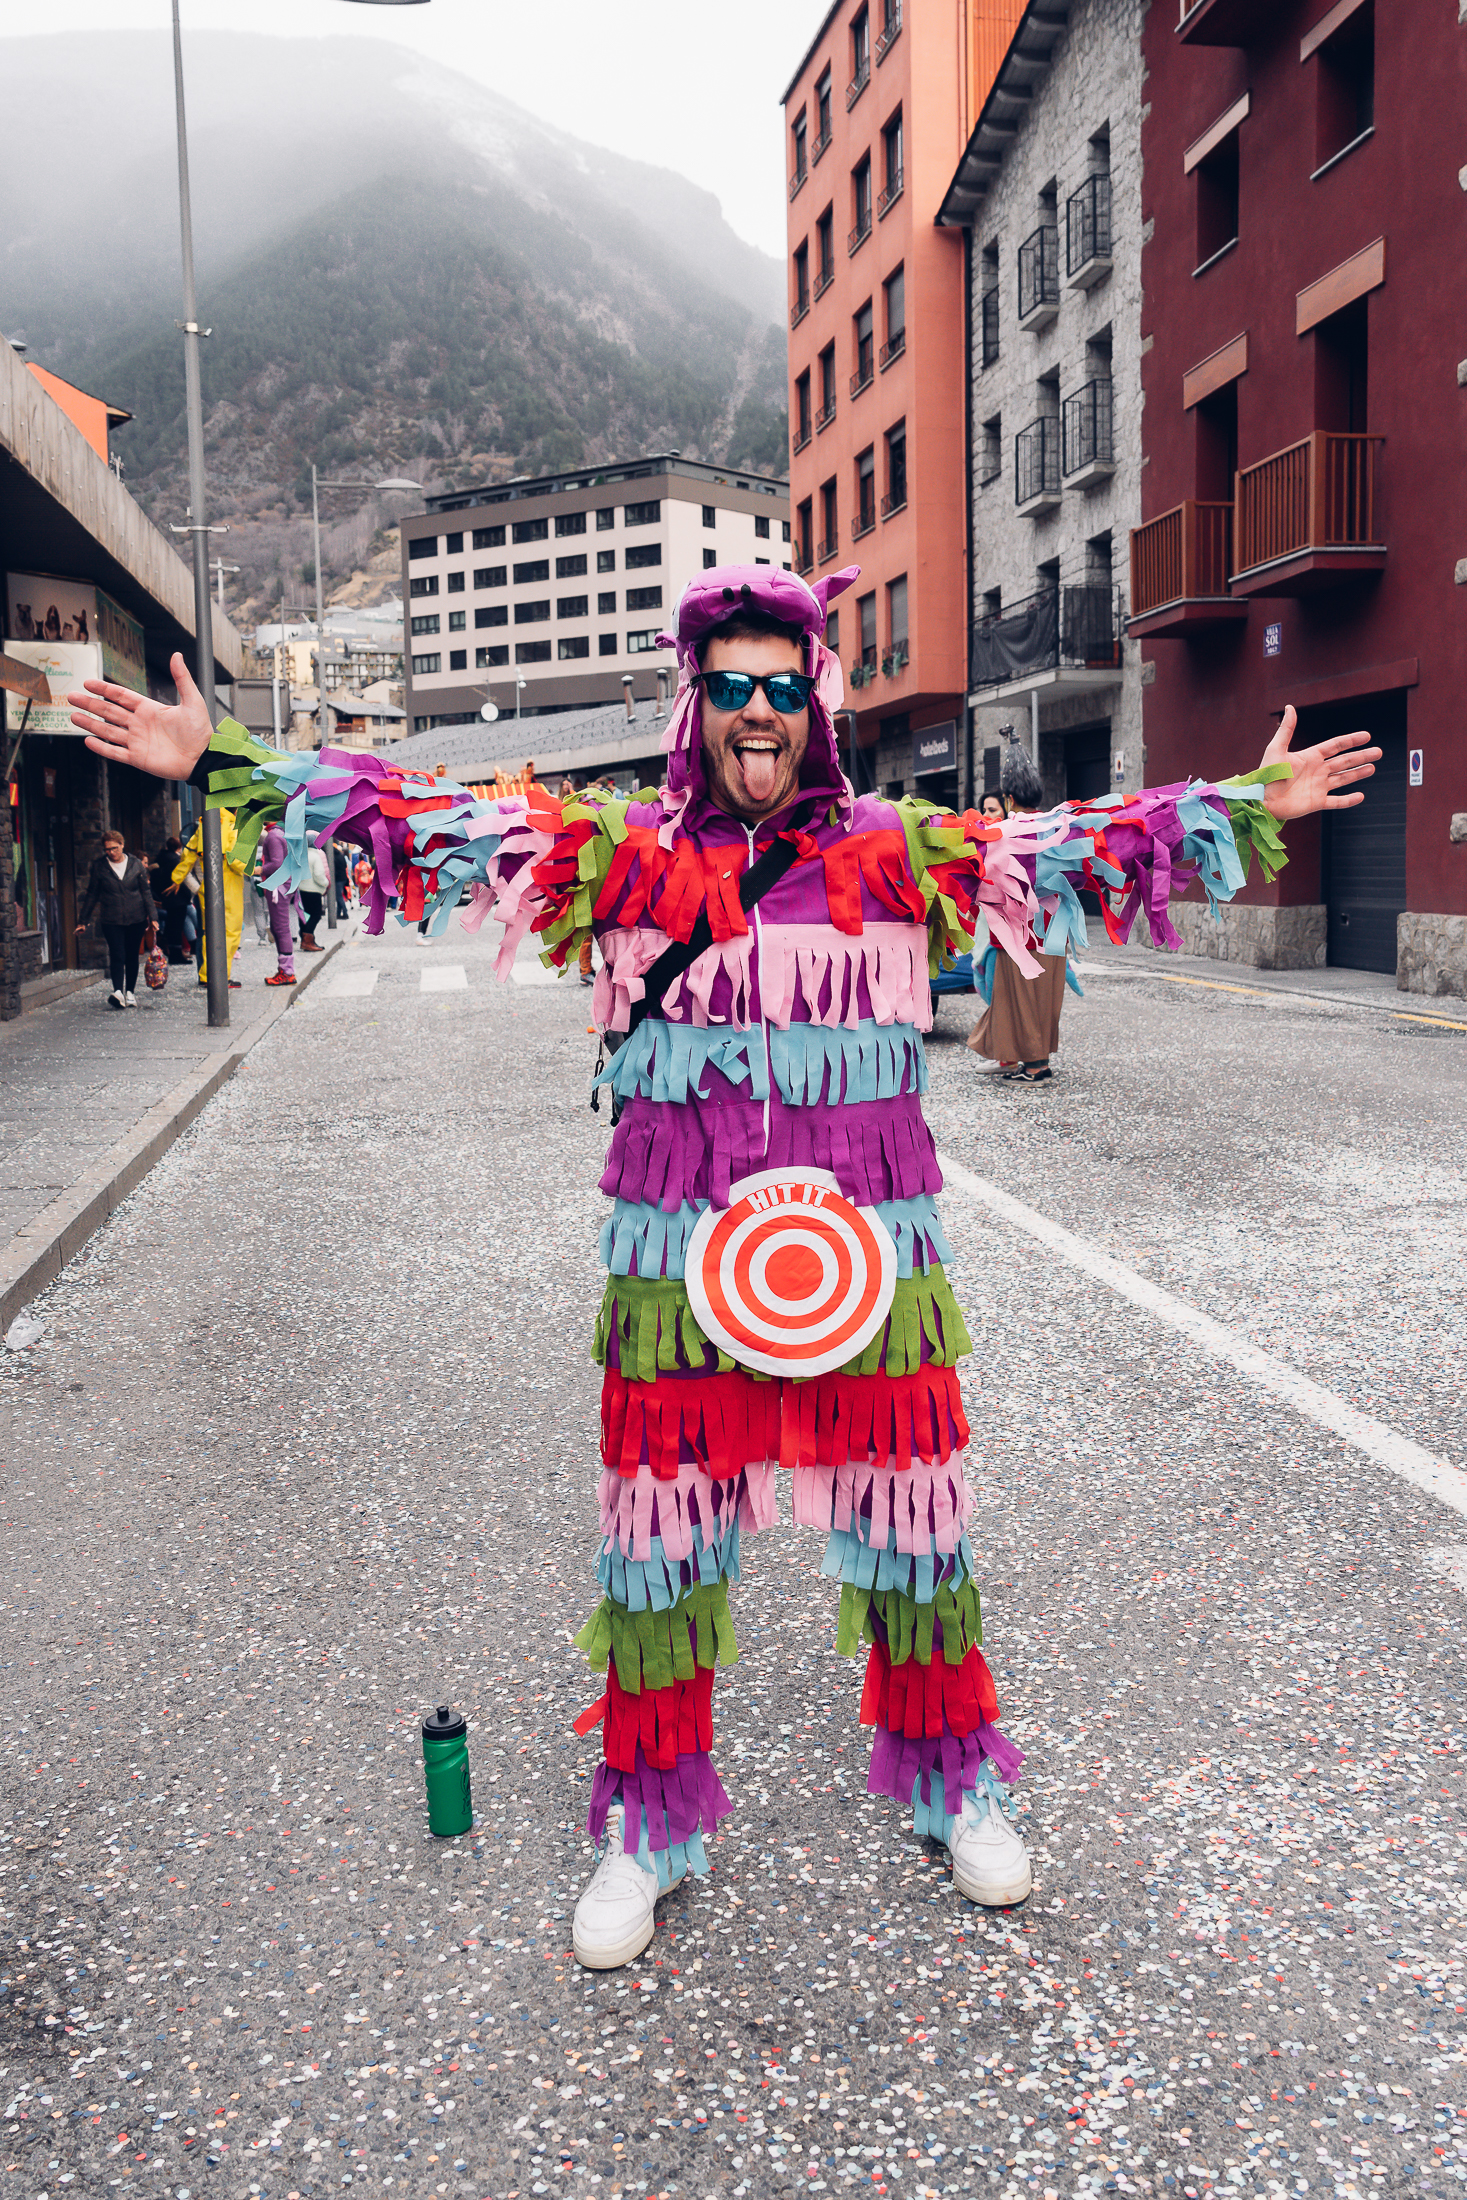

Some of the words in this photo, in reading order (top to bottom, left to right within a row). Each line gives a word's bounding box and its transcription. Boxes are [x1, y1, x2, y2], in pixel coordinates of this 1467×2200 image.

[1265, 634, 1279, 647] SOL
[745, 1182, 796, 1214] HIT
[801, 1182, 832, 1208] IT
